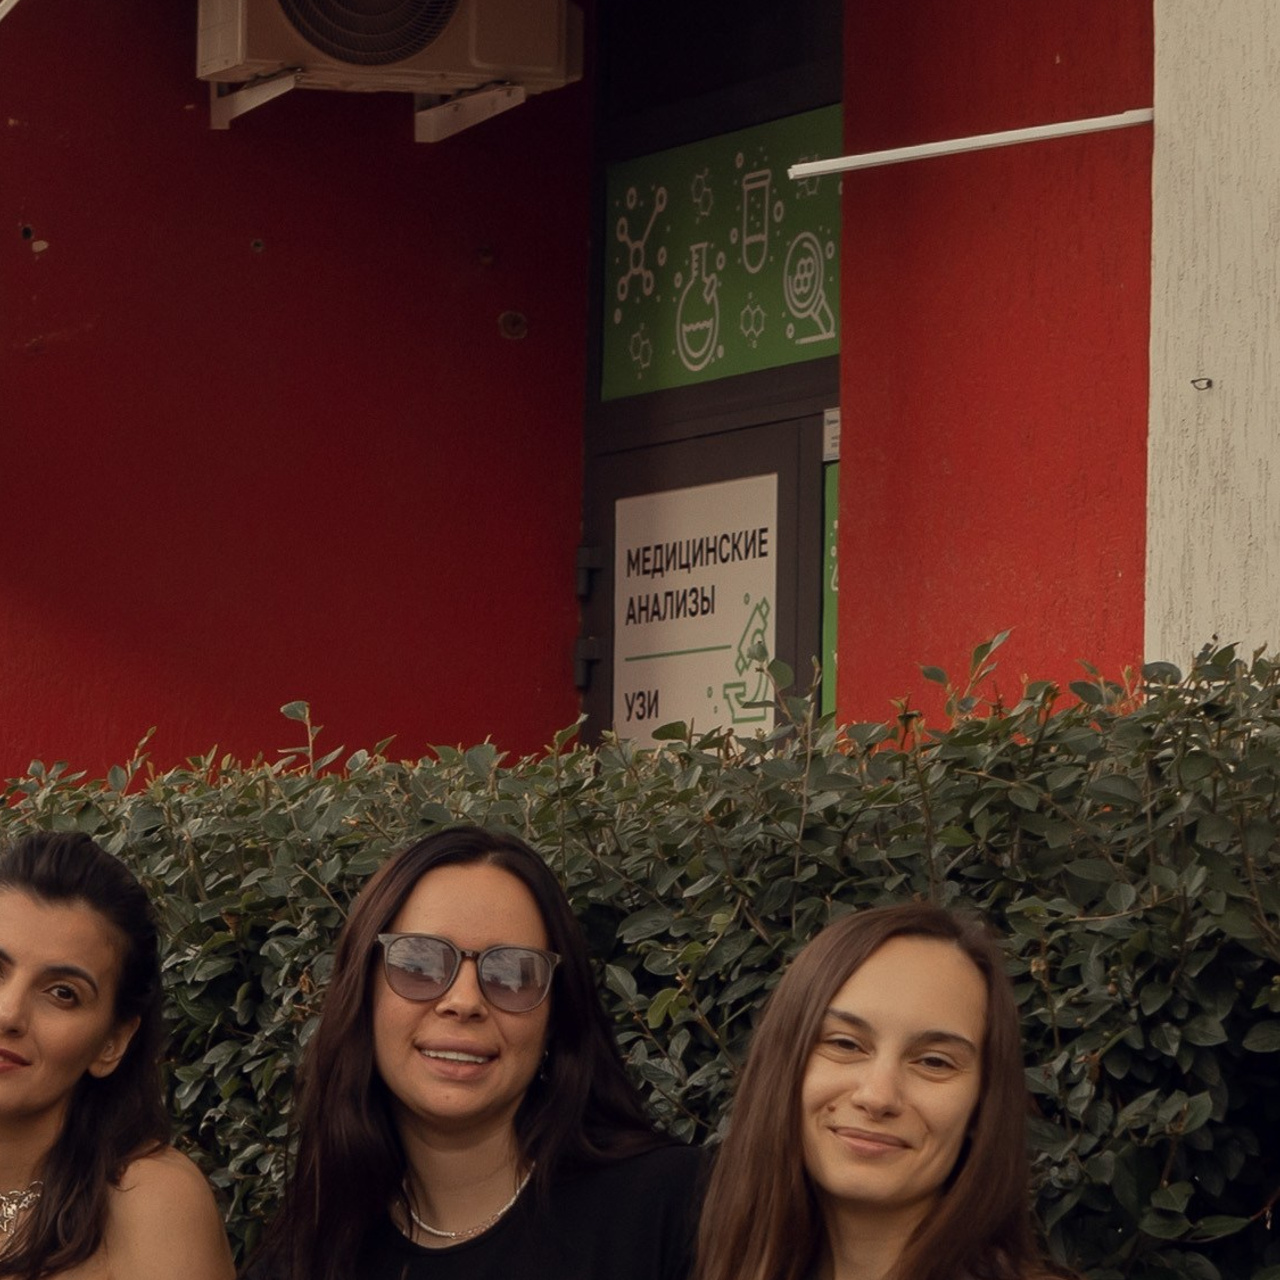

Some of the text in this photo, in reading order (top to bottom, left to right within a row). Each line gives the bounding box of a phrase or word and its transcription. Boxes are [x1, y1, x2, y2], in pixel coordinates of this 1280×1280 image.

[626, 527, 769, 579] МЕДИЦИНСКИЕ
[625, 584, 716, 626] АНАЛИЗЫ
[624, 689, 660, 722] УЗИ
